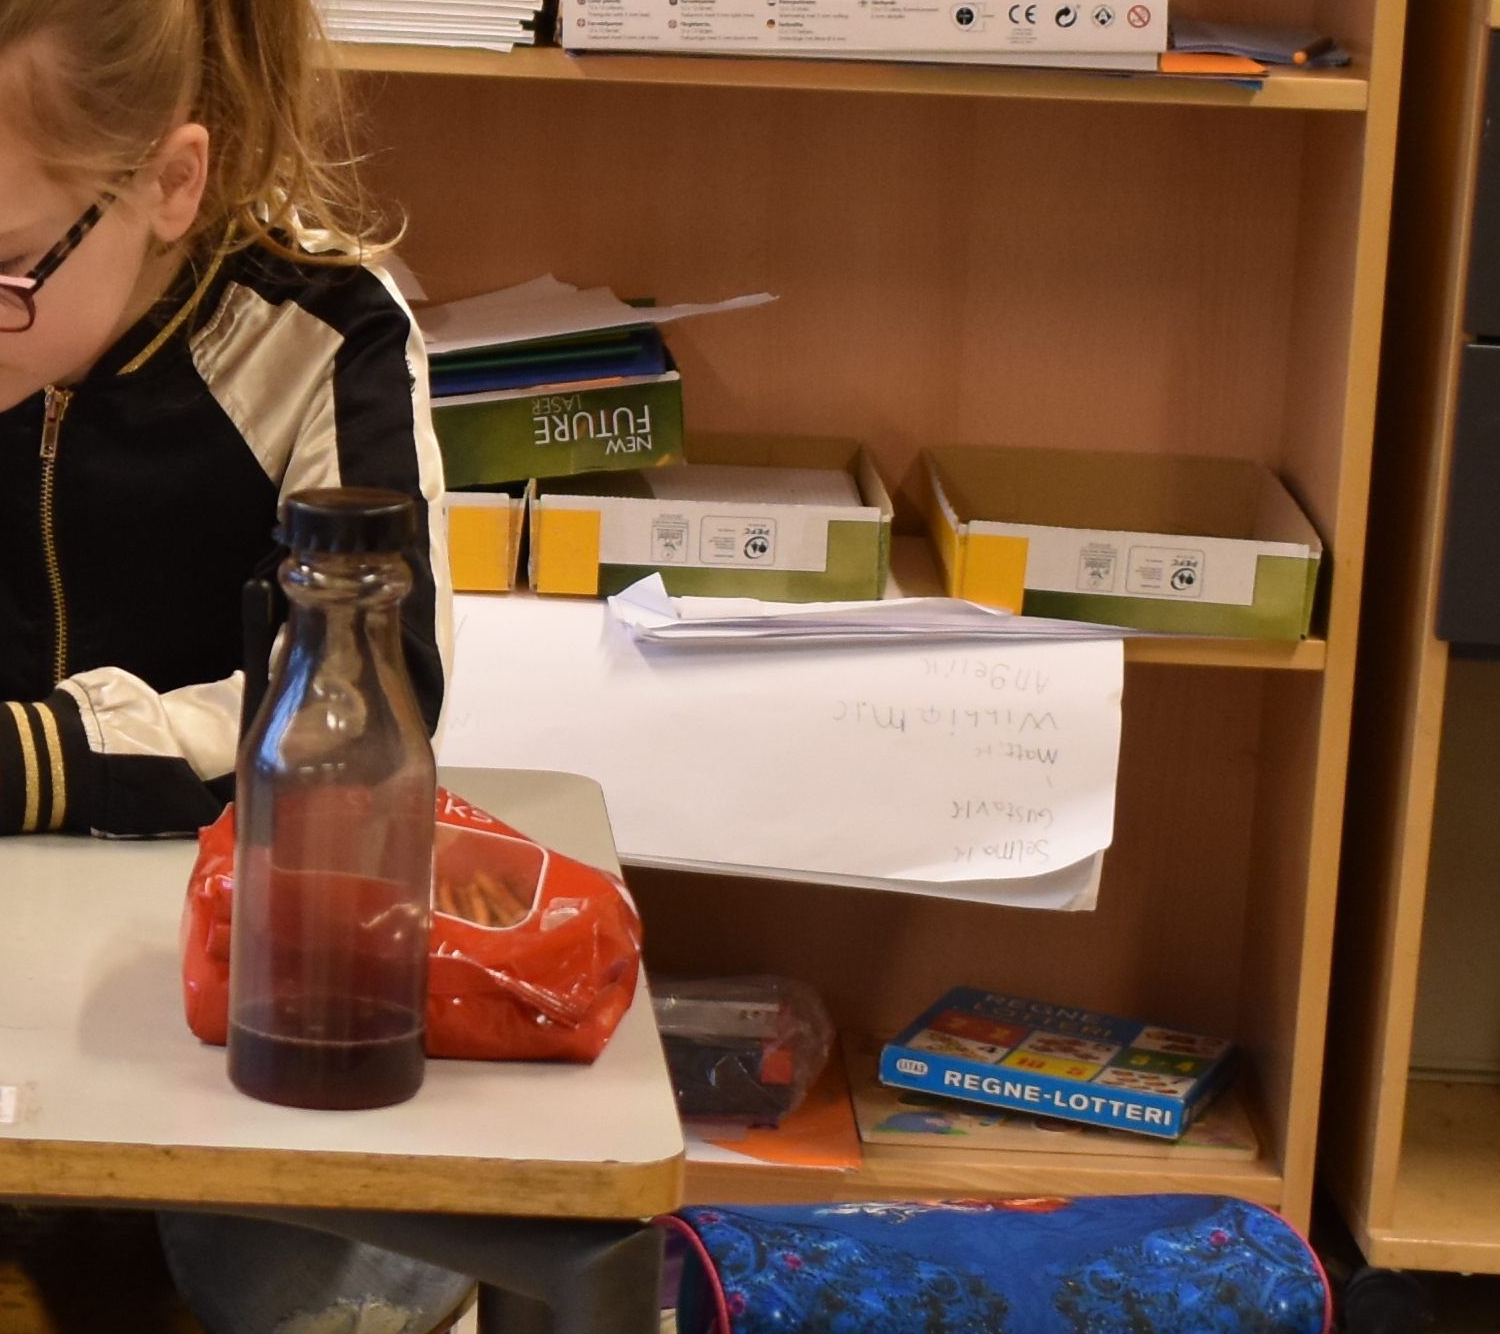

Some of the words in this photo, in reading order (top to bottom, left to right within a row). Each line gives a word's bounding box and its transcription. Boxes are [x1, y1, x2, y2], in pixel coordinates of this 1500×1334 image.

[530, 393, 582, 415] LASER
[532, 404, 651, 445] FUTURE
[605, 434, 653, 455] NEW
[943, 1069, 1173, 1127] REGNE-LOTTERI
